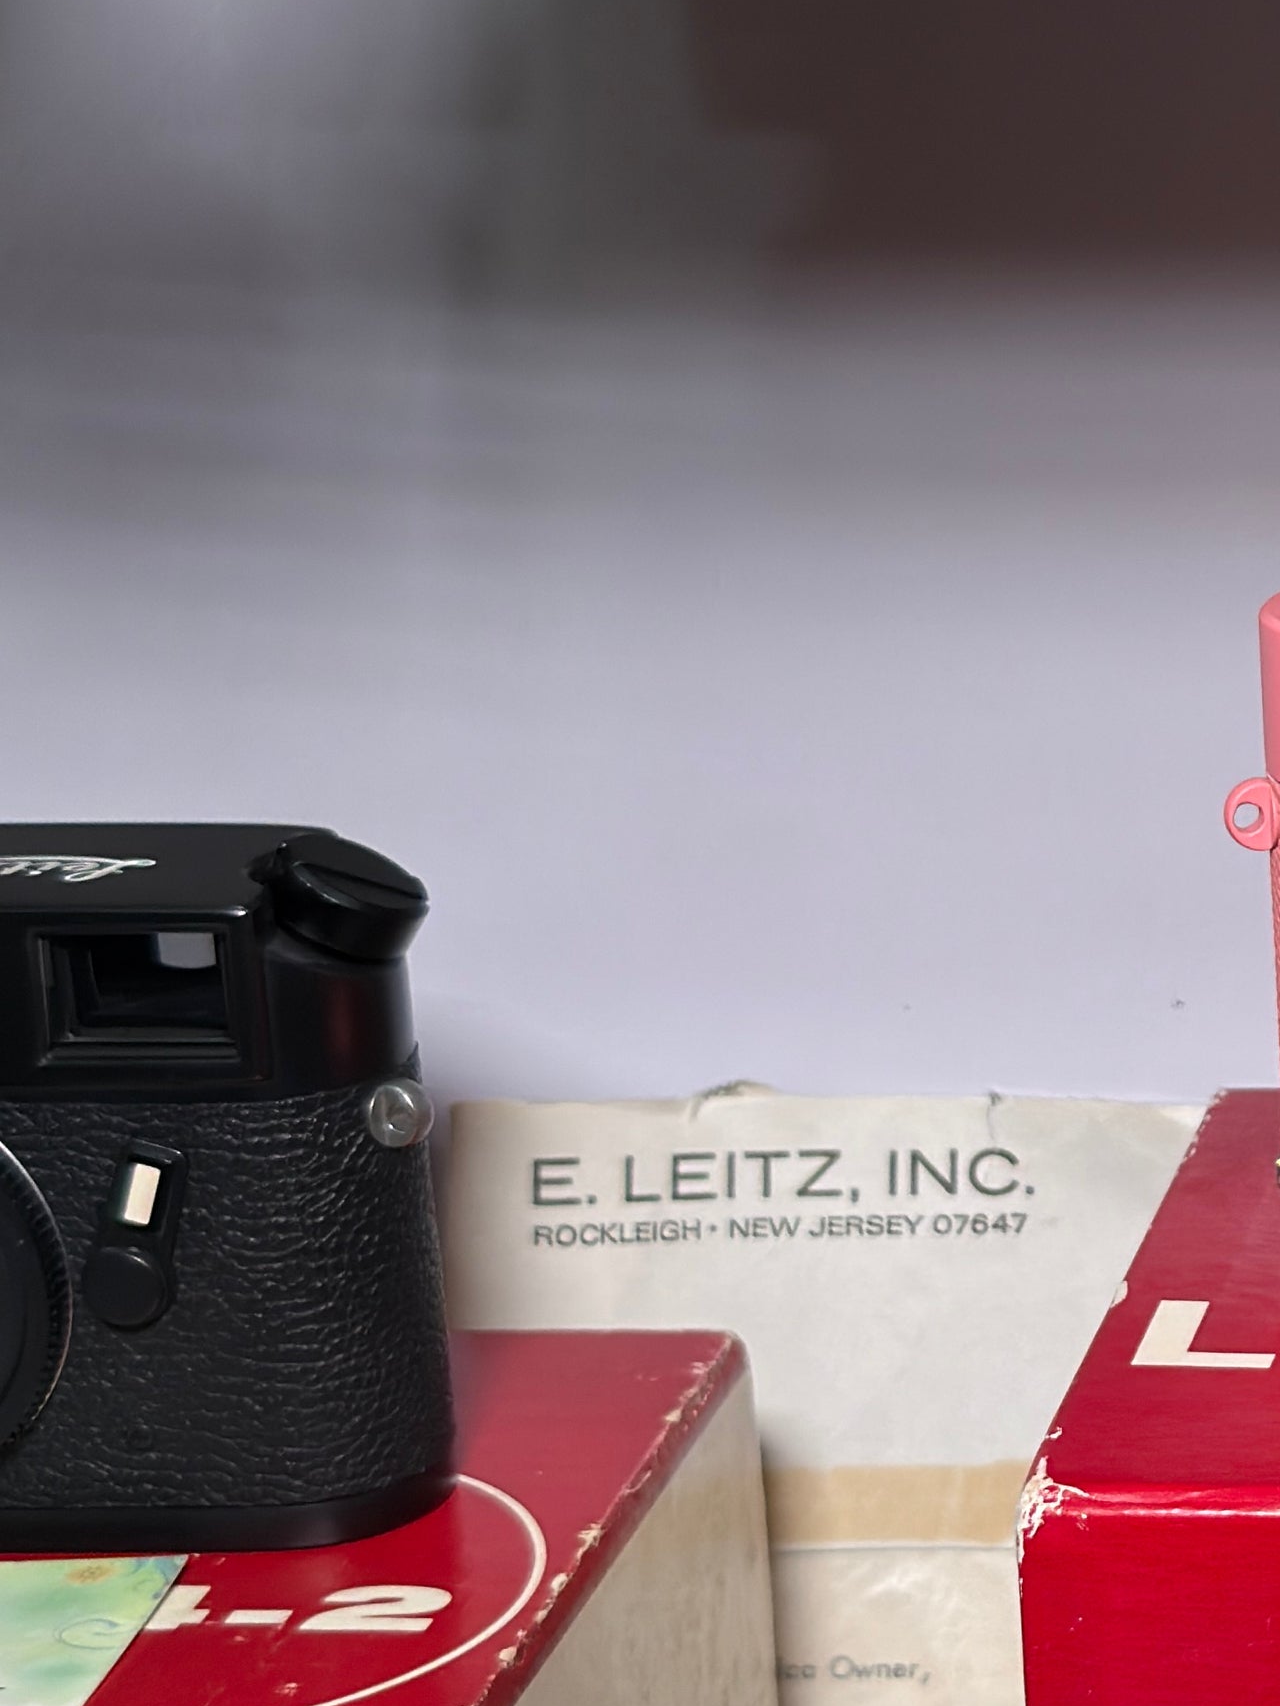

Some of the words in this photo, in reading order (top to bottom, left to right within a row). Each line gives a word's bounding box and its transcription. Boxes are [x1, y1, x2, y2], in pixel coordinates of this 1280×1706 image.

[531, 1156, 597, 1207] E.
[624, 1148, 860, 1204] LEITZ,
[887, 1146, 1036, 1199] INC.
[728, 1215, 801, 1240] NEW
[808, 1213, 924, 1239] JERSEY
[932, 1211, 1029, 1236] 07647
[828, 1654, 932, 1687] Owner,
